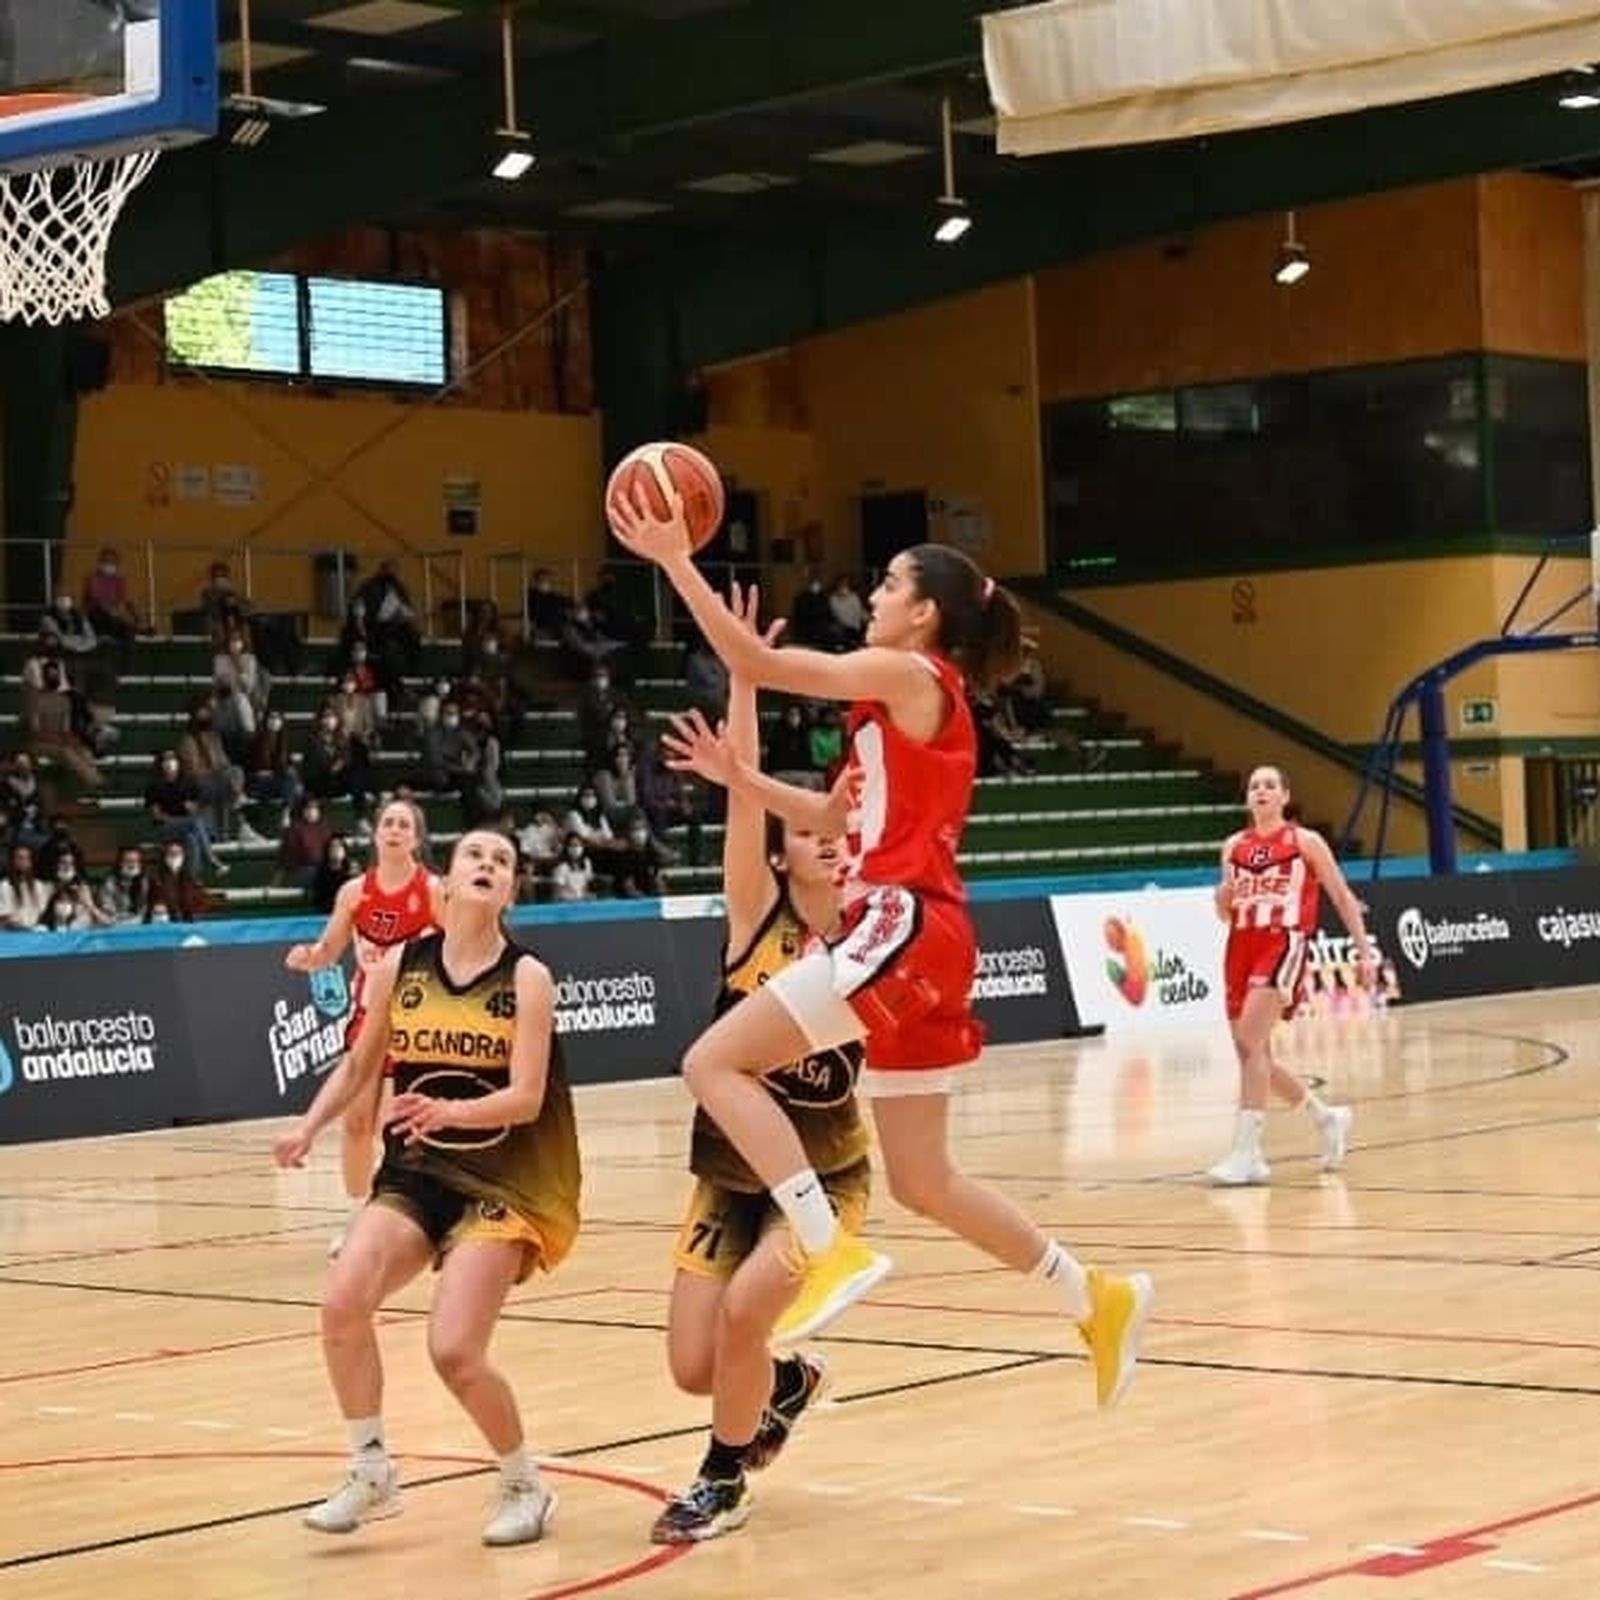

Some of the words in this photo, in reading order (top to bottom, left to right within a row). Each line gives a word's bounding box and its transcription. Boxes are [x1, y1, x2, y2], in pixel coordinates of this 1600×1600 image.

[976, 946, 1046, 975] loncesto
[486, 991, 517, 1020] 45
[553, 971, 655, 1005] aloncesto
[12, 1009, 156, 1050] baloncesto
[273, 1000, 319, 1047] San
[688, 1222, 723, 1260] 71
